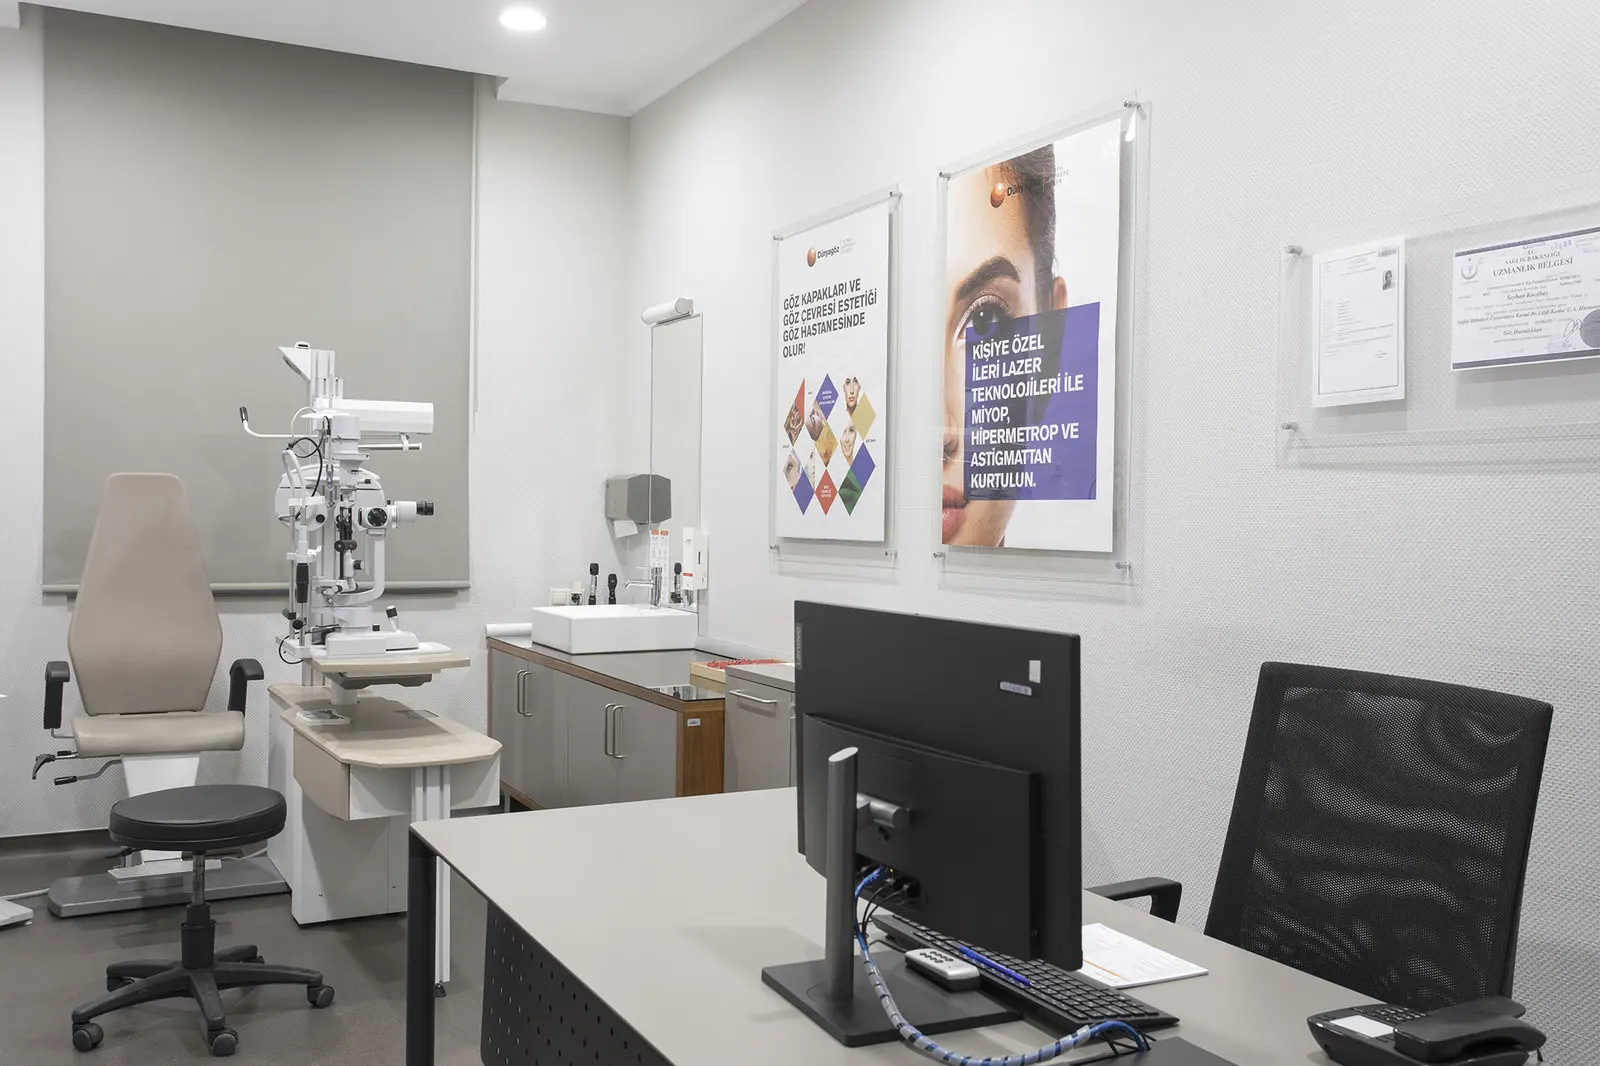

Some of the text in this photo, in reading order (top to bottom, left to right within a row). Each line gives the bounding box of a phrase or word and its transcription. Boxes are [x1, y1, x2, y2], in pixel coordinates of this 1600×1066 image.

[817, 245, 839, 258] Dünyagöz
[1493, 256, 1573, 276] UZMANLIK BELGESİ
[783, 278, 861, 310] GÖZ KAPAKLARI VE
[783, 288, 877, 326] GÖZ ÇEVRESİ ESTETİĞİ
[783, 312, 866, 342] GÖZ HASTANESİNDE
[783, 342, 806, 358] OLUR!
[972, 334, 1045, 361] KİŞİYE ÖZEL
[972, 357, 1042, 381] İLERİ LAZER
[971, 372, 1084, 403] TEKNOLOJİLERİ İLE
[971, 405, 1010, 424] MİYOP,
[971, 422, 1079, 445] HİPERMETROP VE
[970, 447, 1052, 467] ASTİGMATTAN
[970, 472, 1036, 488] KURTULUN.
